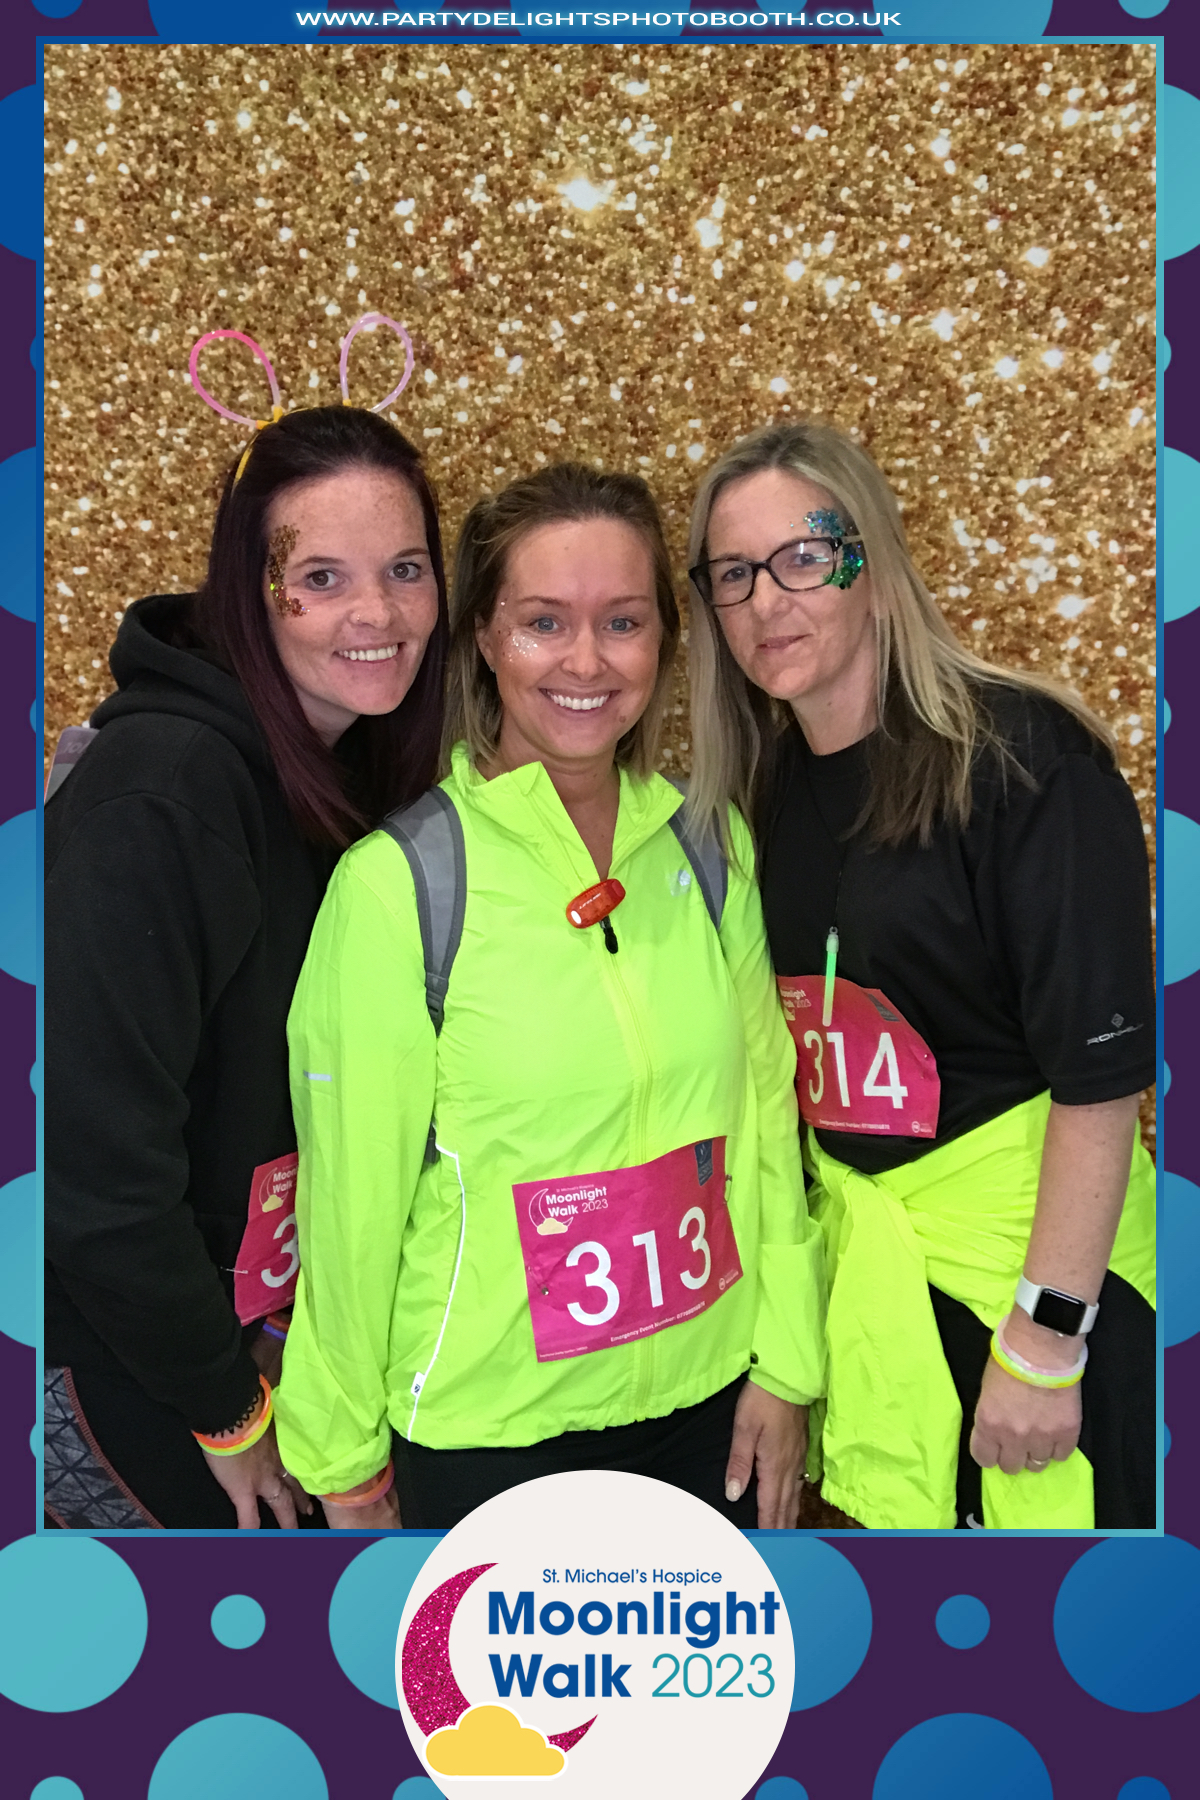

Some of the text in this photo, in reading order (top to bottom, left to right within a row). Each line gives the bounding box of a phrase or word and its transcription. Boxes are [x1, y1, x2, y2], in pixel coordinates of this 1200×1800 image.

[803, 1029, 909, 1109] 314
[272, 1180, 293, 1194] Walk
[545, 1186, 608, 1205] Moonlight
[548, 1198, 609, 1218] Walk 2023
[260, 1212, 301, 1288] 3
[565, 1206, 713, 1326] 313
[610, 1329, 639, 1342] Emergency
[639, 1323, 654, 1333] Event
